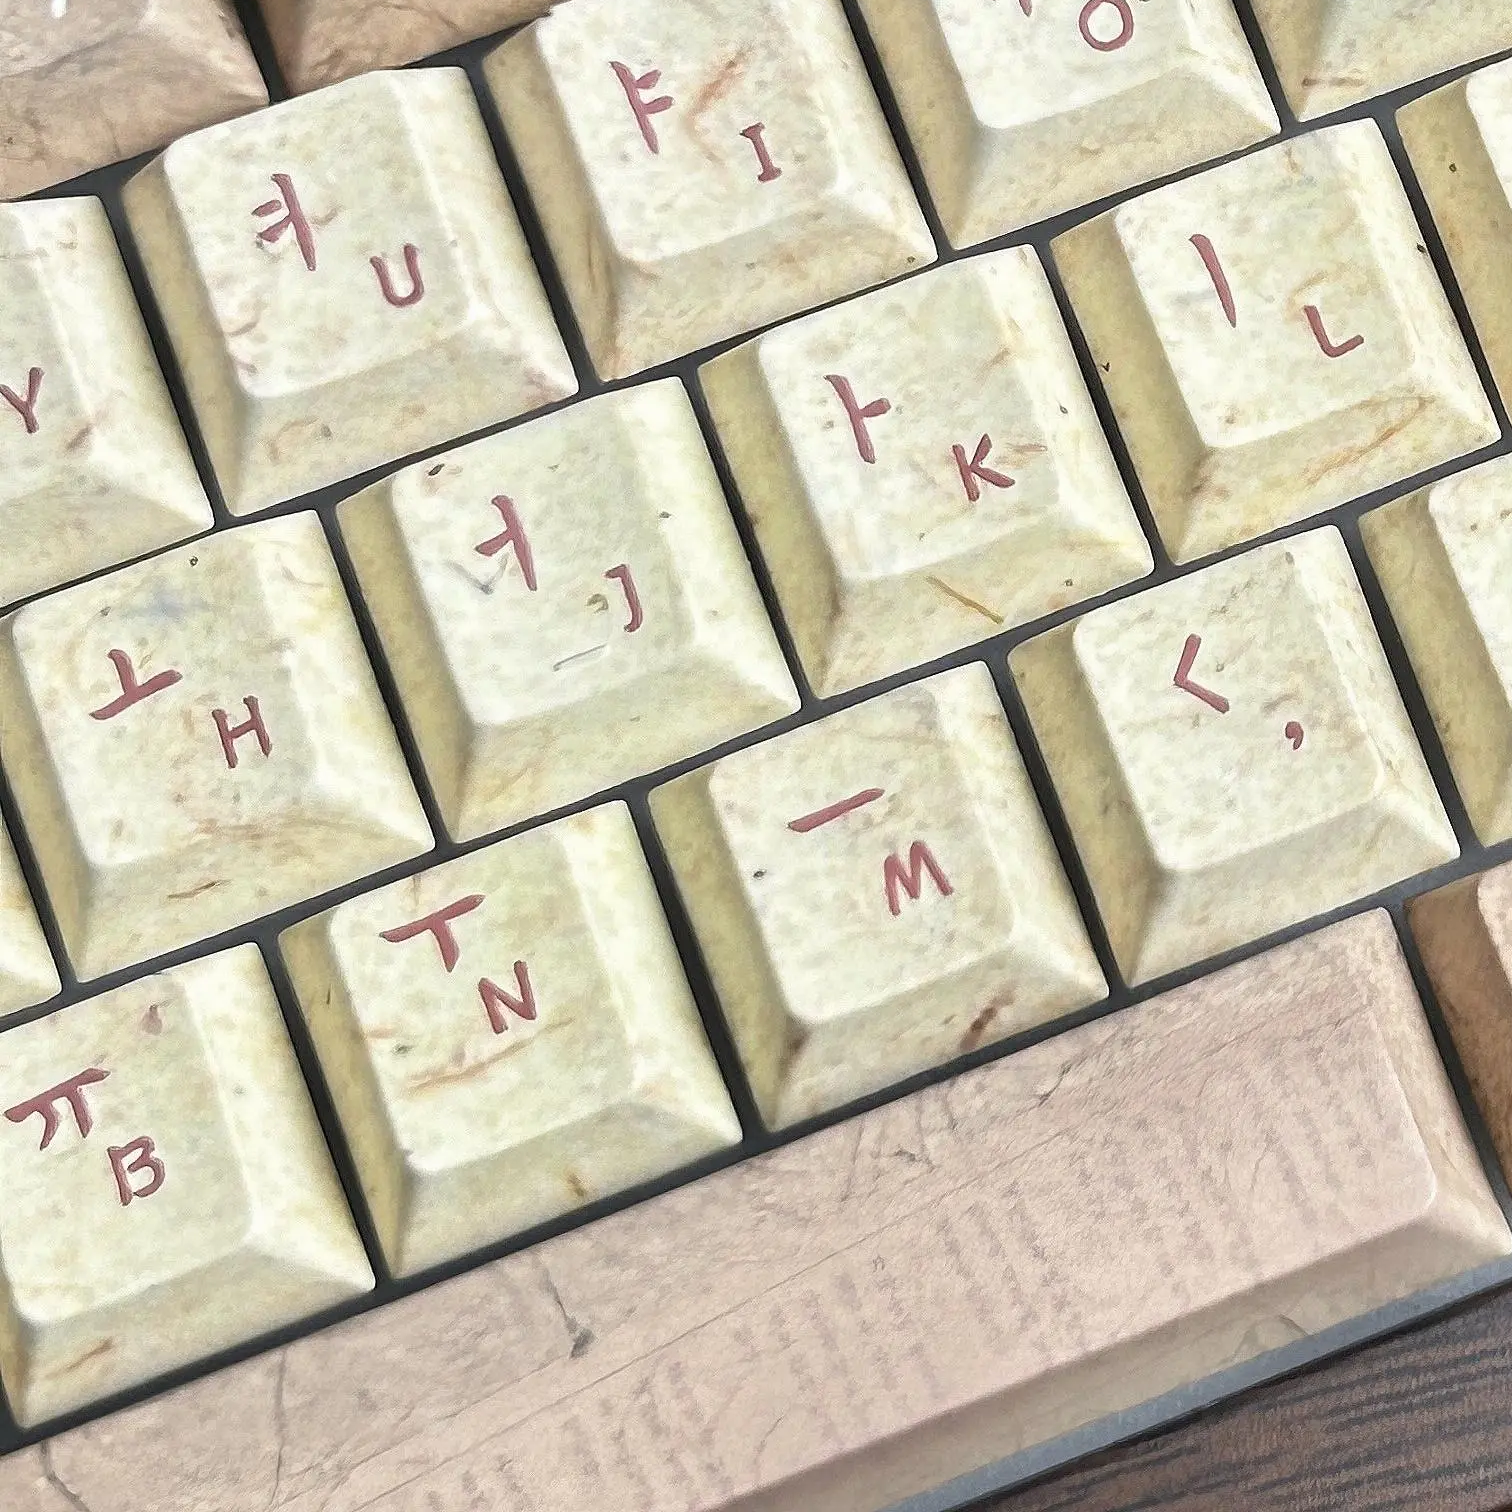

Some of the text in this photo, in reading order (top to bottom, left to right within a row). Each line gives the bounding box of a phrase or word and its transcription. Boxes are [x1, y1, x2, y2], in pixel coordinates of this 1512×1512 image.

[740, 122, 782, 183] I
[369, 243, 424, 307] U
[1304, 305, 1365, 358] L
[0, 367, 44, 434] Y
[953, 434, 1015, 503] K
[605, 564, 643, 633] J
[1173, 634, 1229, 714] <
[212, 696, 271, 769] H
[883, 841, 953, 916] M
[477, 959, 536, 1035] N
[105, 1134, 166, 1207] B
